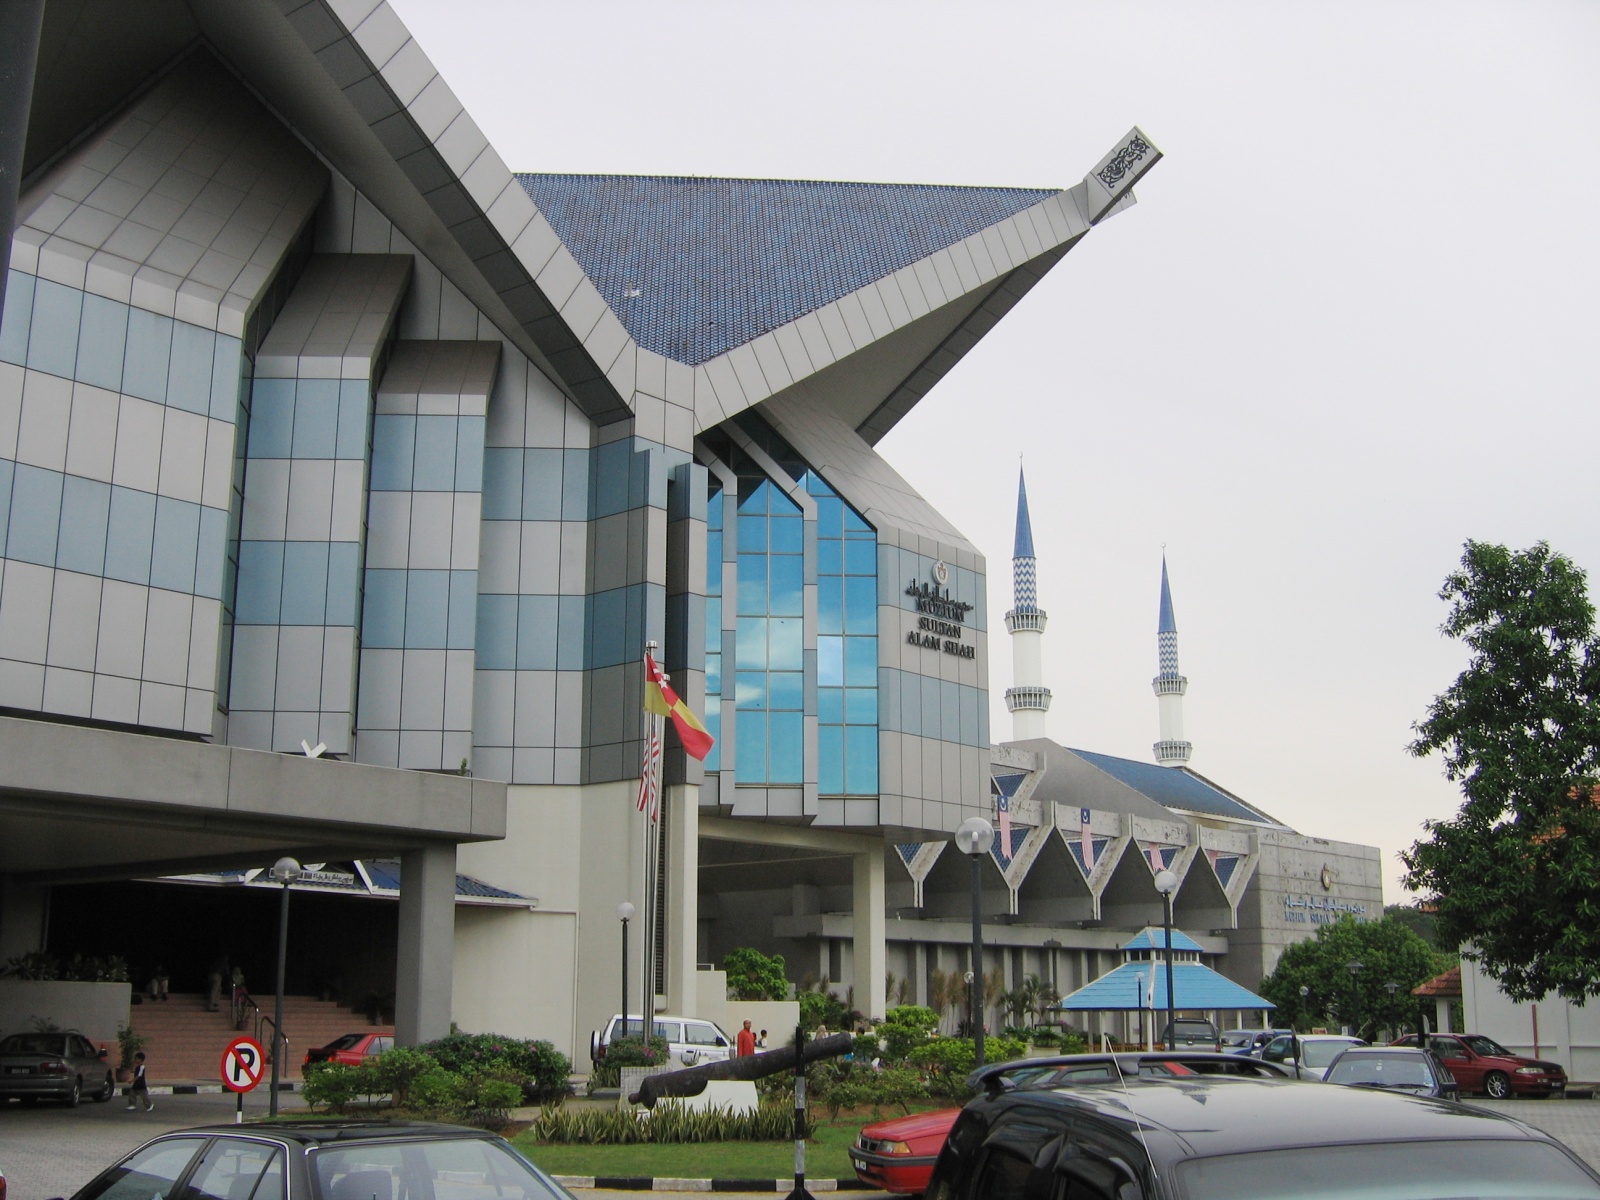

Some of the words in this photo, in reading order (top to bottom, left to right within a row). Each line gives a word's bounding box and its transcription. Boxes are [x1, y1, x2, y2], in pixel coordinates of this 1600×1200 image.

[919, 616, 961, 639] SULTAN
[907, 630, 941, 651] ALAM
[944, 640, 975, 659] SHAH
[233, 1047, 255, 1082] P
